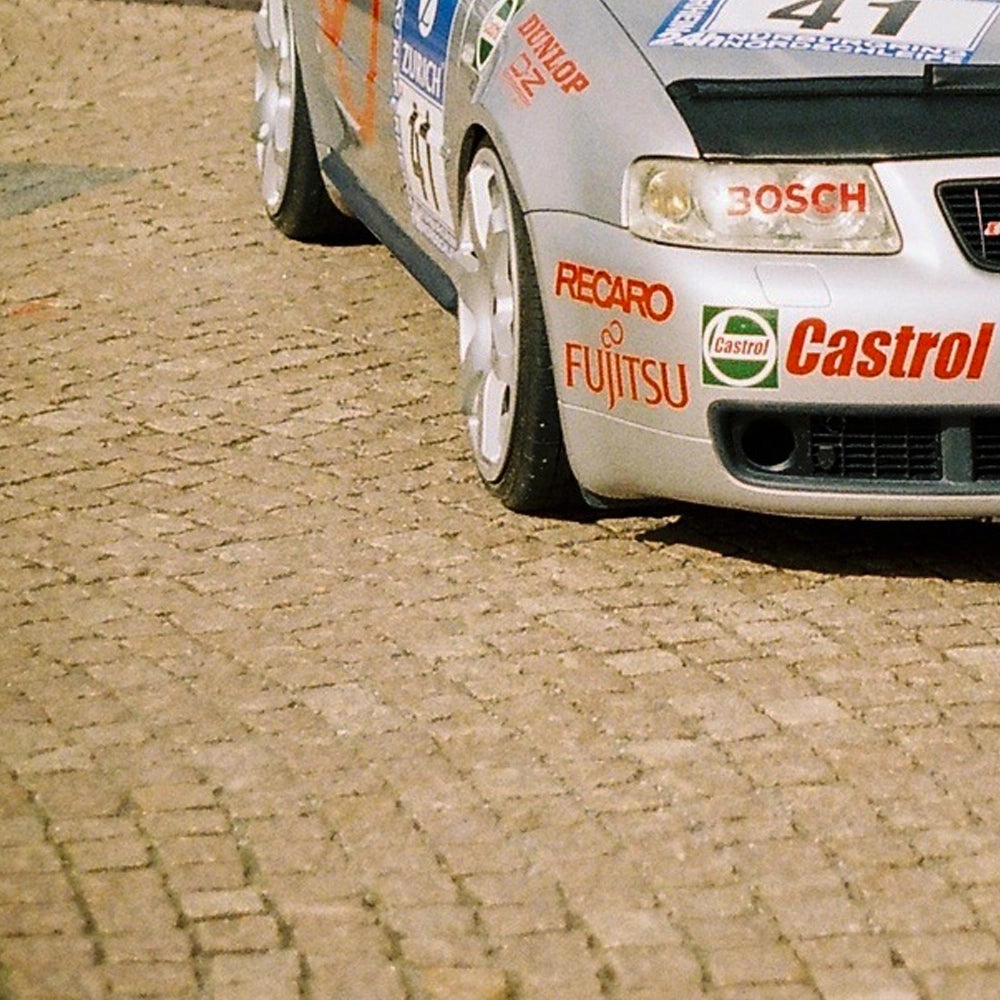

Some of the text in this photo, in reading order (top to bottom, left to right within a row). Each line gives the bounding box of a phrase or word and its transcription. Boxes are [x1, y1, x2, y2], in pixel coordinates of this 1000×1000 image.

[517, 12, 590, 94] DUNLOP
[727, 182, 868, 216] BOSCH
[555, 260, 675, 323] RECARO
[564, 341, 691, 411] FUJITSU
[713, 336, 770, 358] Castrol
[785, 317, 996, 380] Castrol
